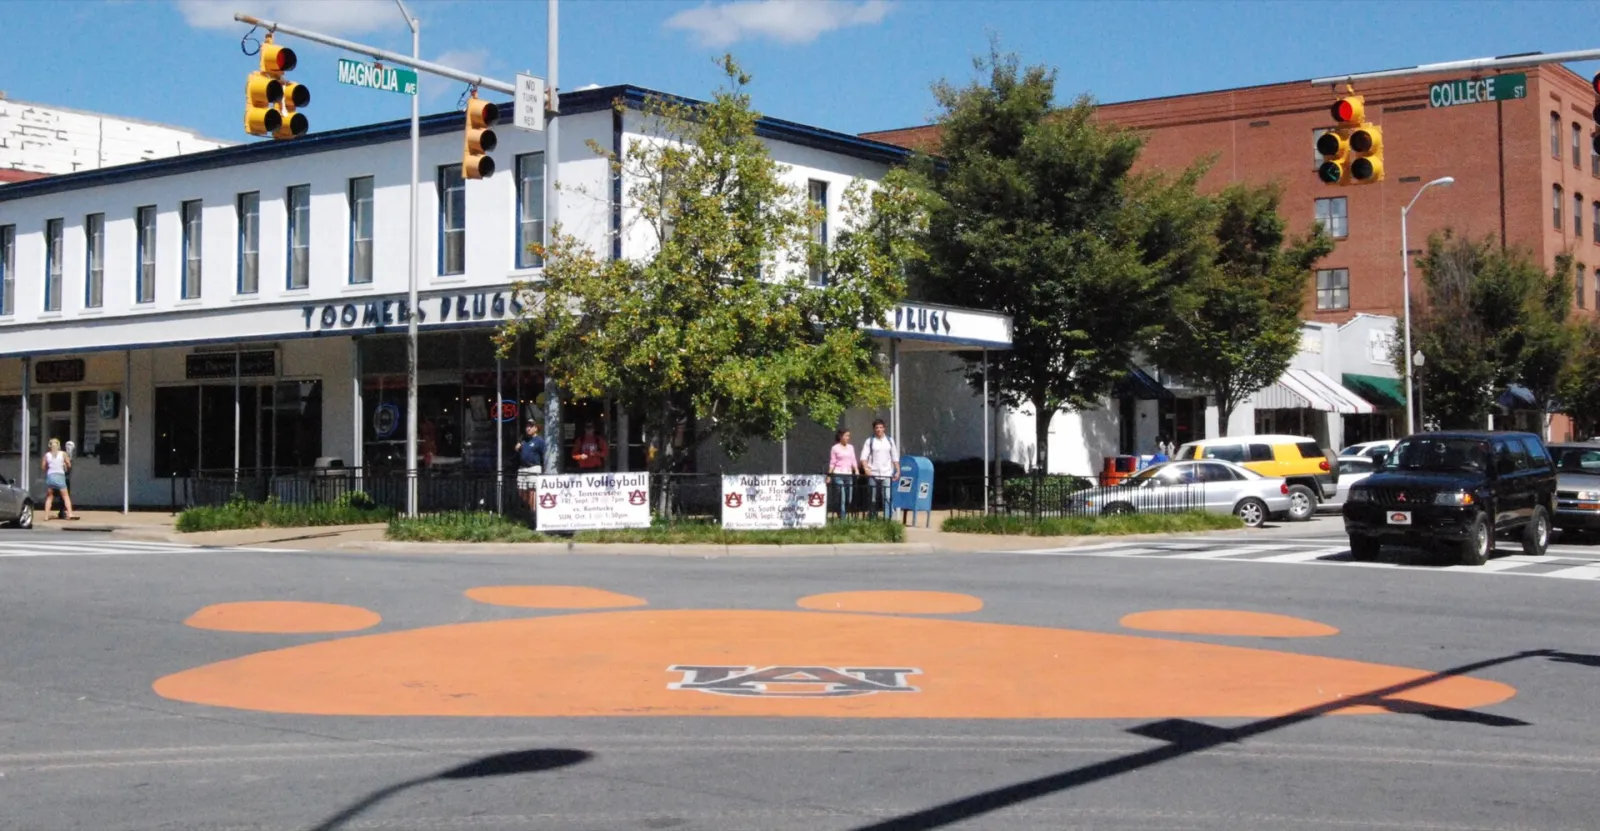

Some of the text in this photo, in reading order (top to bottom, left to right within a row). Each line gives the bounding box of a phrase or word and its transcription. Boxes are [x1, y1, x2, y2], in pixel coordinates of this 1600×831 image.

[338, 60, 416, 94] MAGNOLIA AVE
[525, 80, 536, 91] NO
[522, 92, 538, 103] TURN
[1430, 78, 1524, 107] COLLEGE ST
[525, 105, 533, 114] ON
[523, 115, 536, 126] RED
[540, 474, 646, 490] Auburn Volleyball
[740, 476, 812, 487] Auburn Soccer
[768, 487, 797, 495] Florida
[758, 505, 776, 513] South
